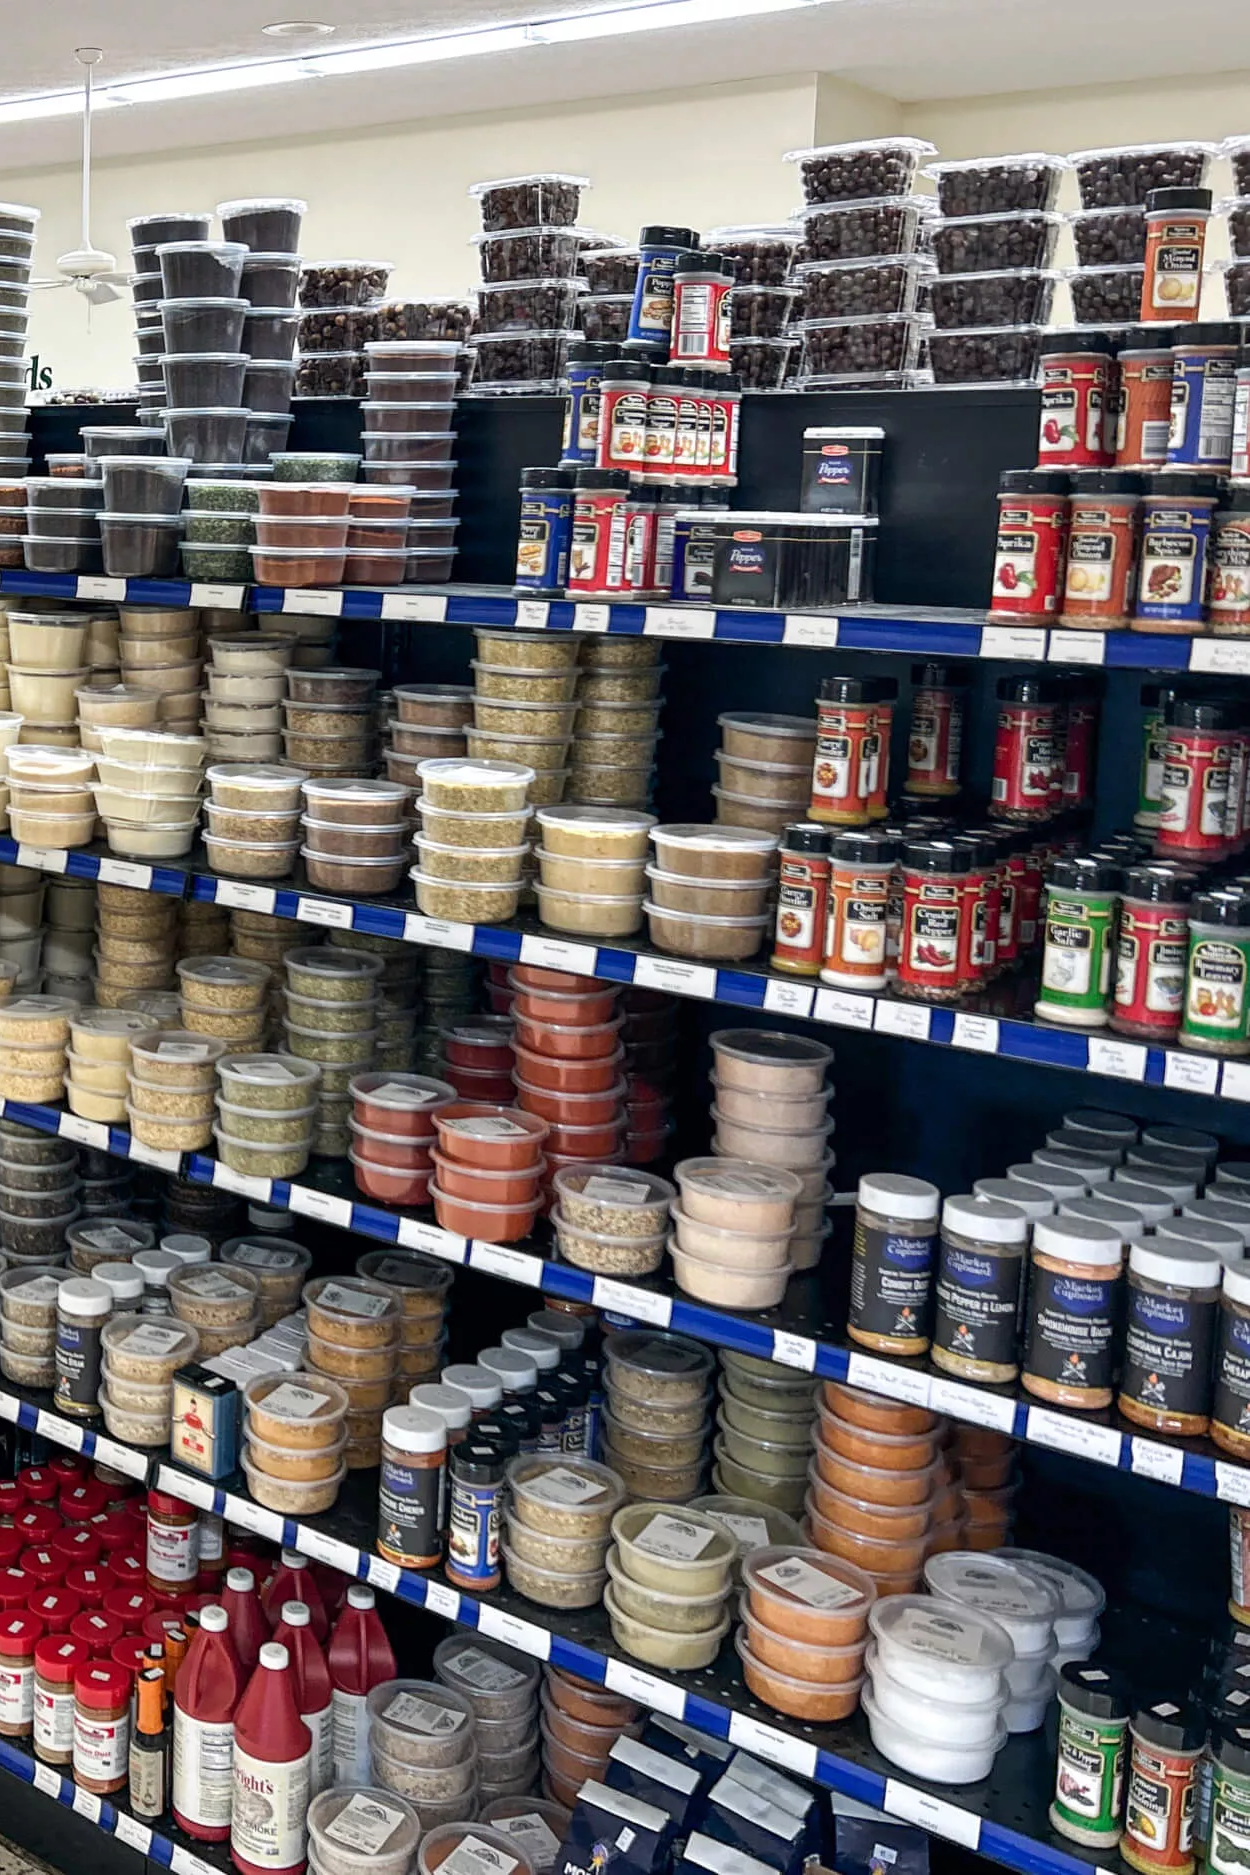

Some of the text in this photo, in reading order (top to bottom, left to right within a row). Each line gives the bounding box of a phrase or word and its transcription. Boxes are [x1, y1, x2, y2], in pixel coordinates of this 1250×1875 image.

[853, 903, 883, 913] Onion
[859, 911, 879, 921] Salt
[917, 909, 956, 920] Crushed
[1050, 926, 1082, 939] Garlic
[1053, 935, 1076, 946] Salt
[235, 1766, 274, 1795] right's
